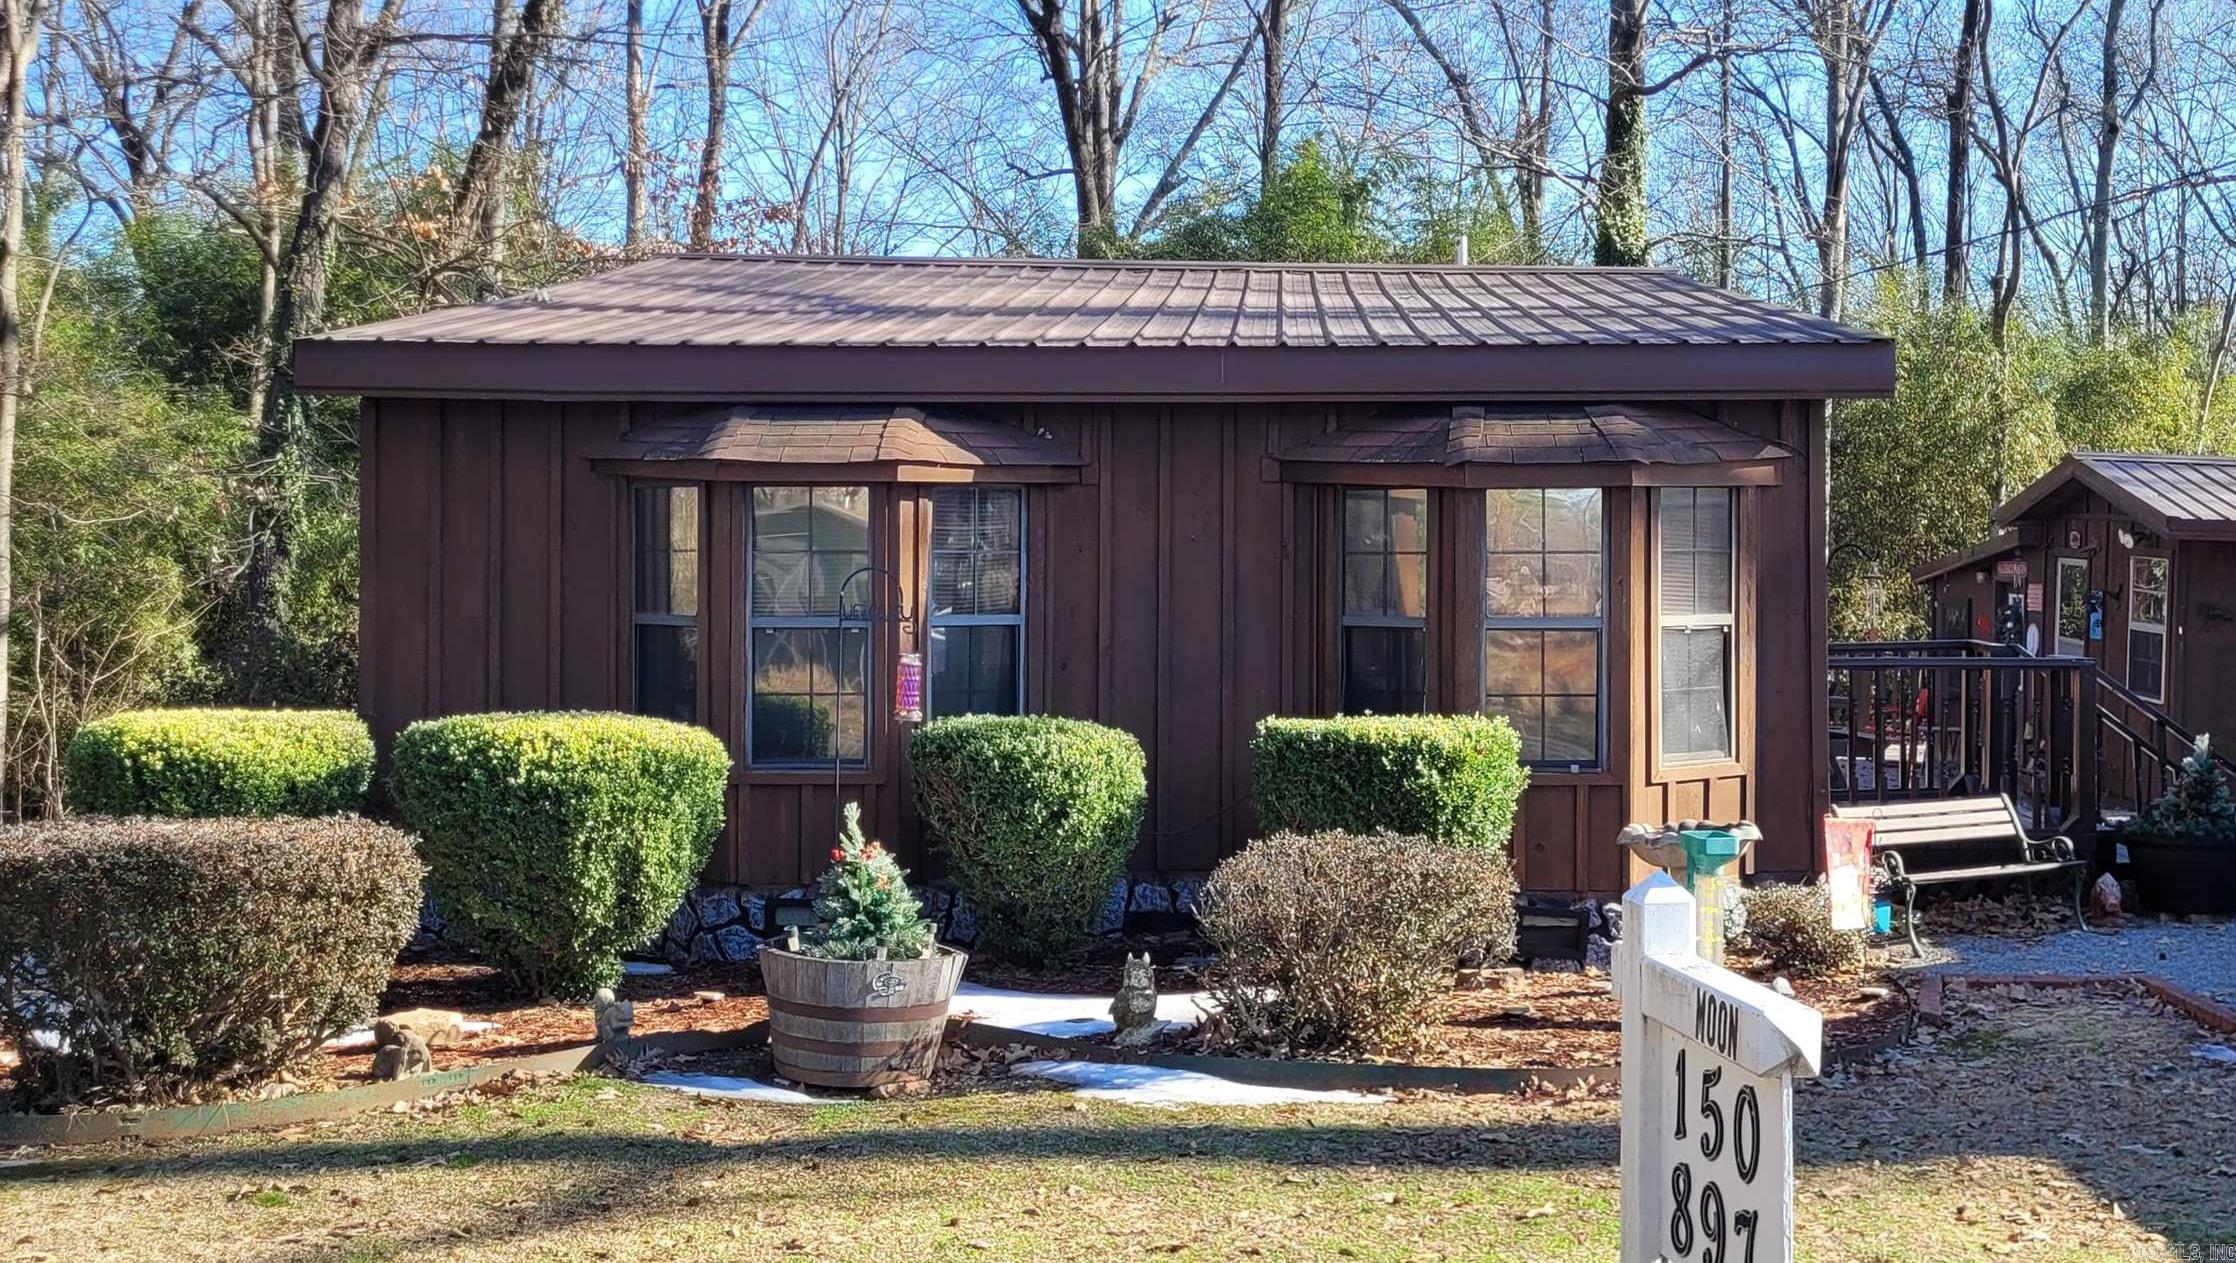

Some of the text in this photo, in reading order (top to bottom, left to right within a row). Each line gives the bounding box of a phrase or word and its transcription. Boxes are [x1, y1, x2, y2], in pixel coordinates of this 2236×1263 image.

[1695, 987, 1739, 1061] MOON
[1674, 1048, 1760, 1185] 150
[1670, 1162, 1758, 1263] 897
